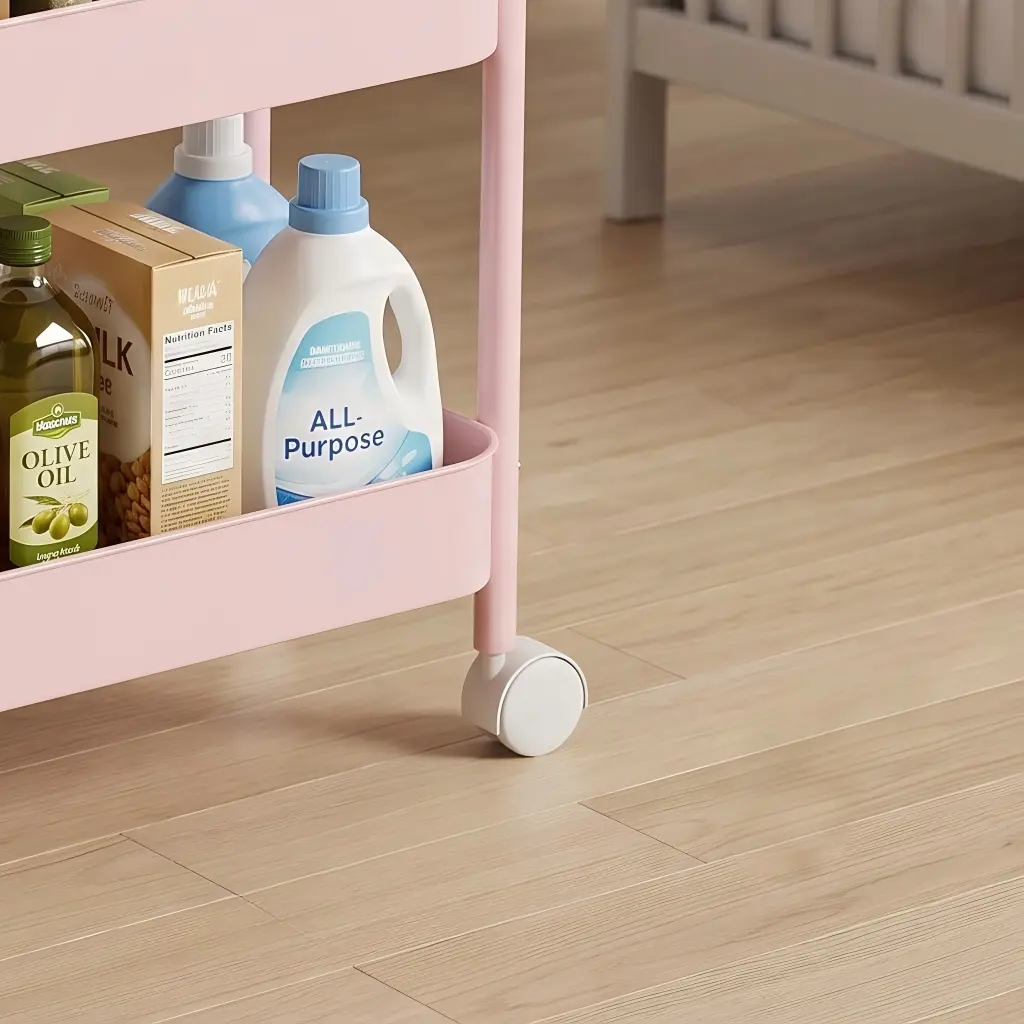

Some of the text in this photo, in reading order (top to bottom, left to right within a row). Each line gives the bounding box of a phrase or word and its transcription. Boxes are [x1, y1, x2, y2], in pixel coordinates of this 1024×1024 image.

[164, 323, 232, 345] Nutrition Facts
[309, 406, 363, 432] ALL-
[21, 439, 91, 470] OLIVE
[284, 429, 385, 461] Purpose
[37, 465, 77, 488] OIL
